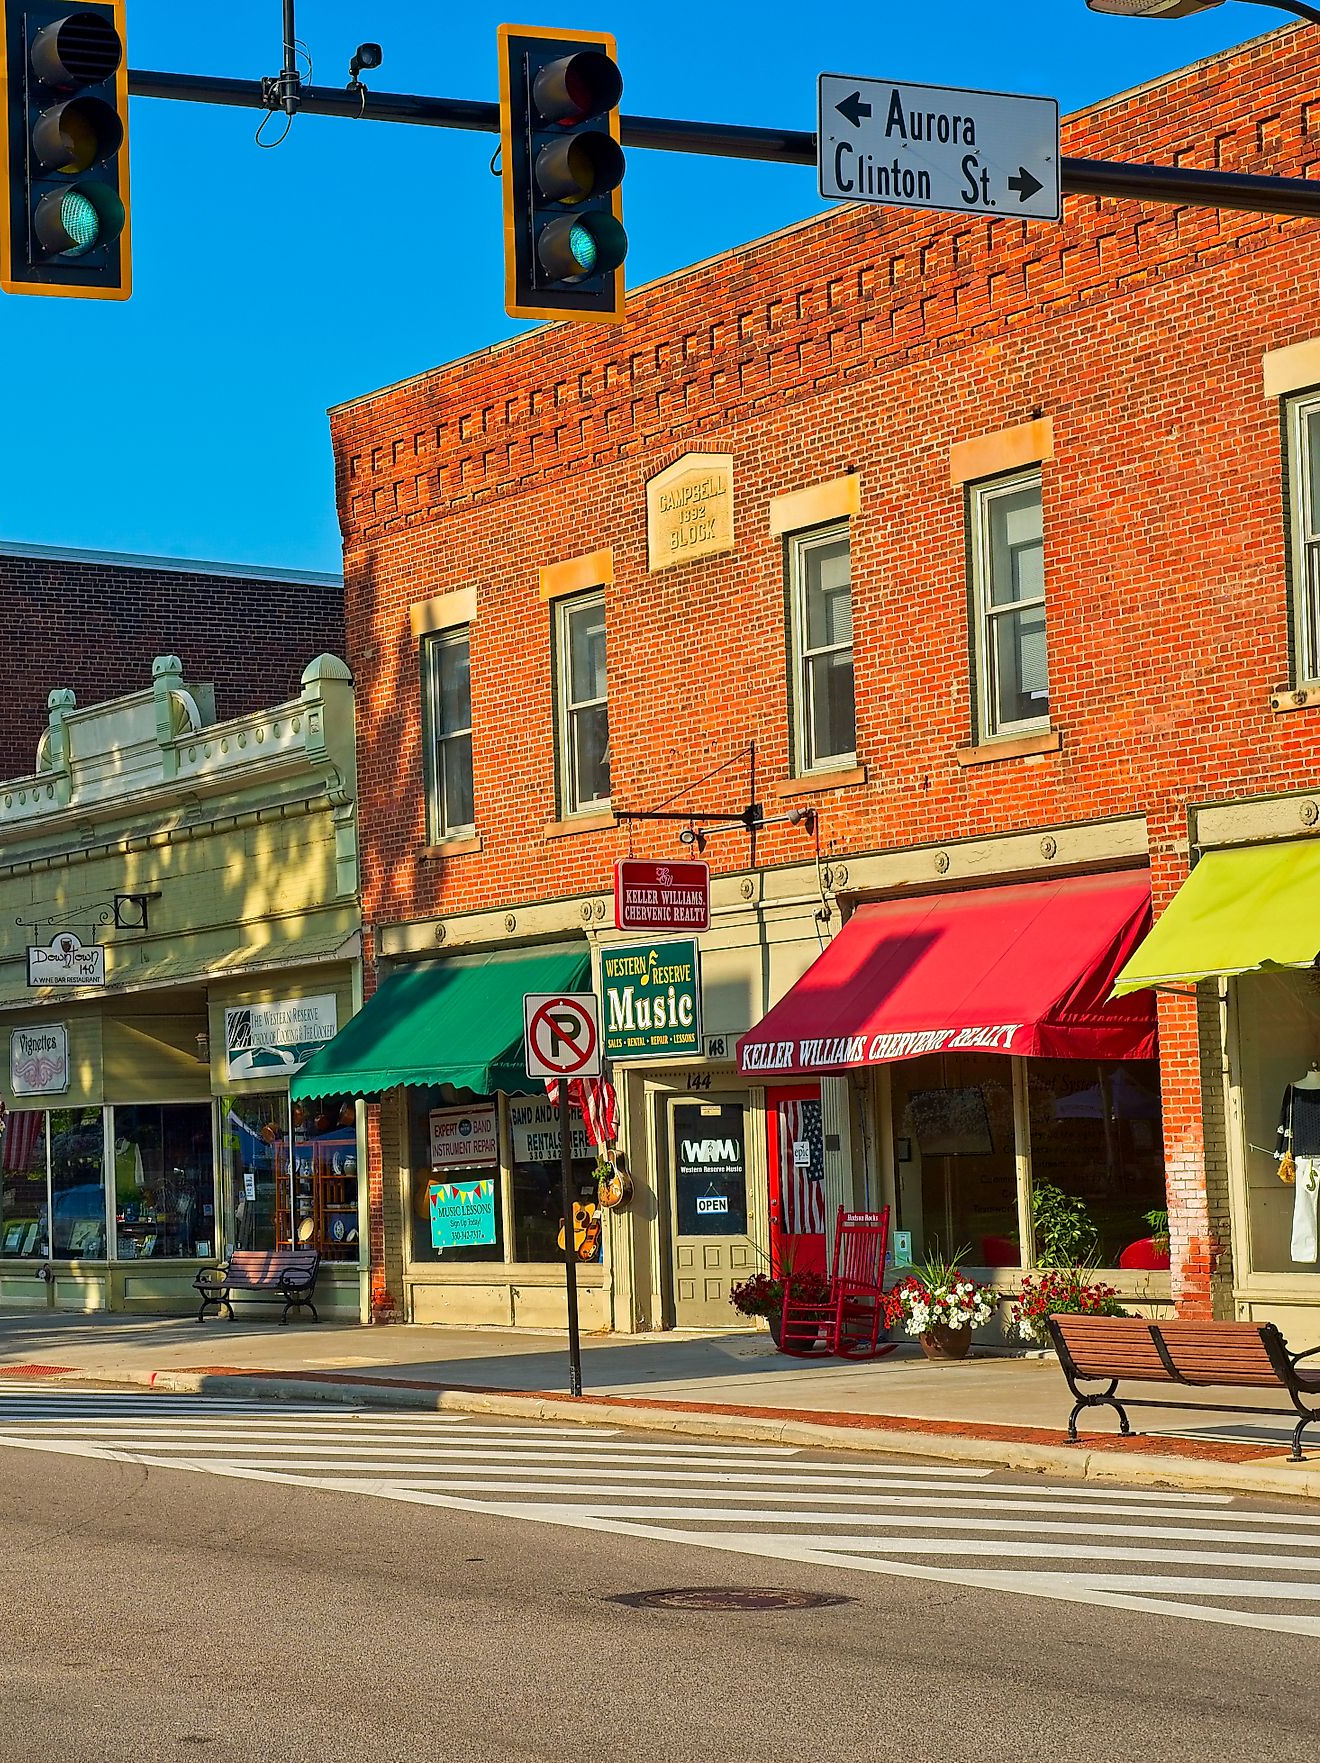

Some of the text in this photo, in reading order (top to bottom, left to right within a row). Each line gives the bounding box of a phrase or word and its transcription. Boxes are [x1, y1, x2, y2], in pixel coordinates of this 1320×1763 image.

[884, 89, 976, 147] Aurora
[834, 141, 996, 207] Clinton St.
[659, 475, 727, 513] CAMPBELL
[670, 518, 716, 550] BLOCK
[625, 889, 659, 905] KELLER
[624, 905, 706, 922] CHERVENIC REALTY
[79, 964, 95, 975] 140
[605, 955, 692, 985] WESTERN RESERVE
[607, 985, 694, 1033] Music
[19, 1033, 57, 1056] Vignettes
[607, 1033, 696, 1049] SALES RENTAL REPAIR LESSONS
[708, 1038, 725, 1056] 148
[741, 1040, 794, 1071] KELLER
[868, 1029, 955, 1061] CHERVENIC
[948, 1023, 1024, 1049] REALTY
[686, 1073, 712, 1090] 144
[511, 1107, 533, 1126] BAND
[535, 1104, 552, 1123] AND
[434, 1122, 458, 1138] EXPERT
[473, 1119, 492, 1134] BAND
[433, 1138, 496, 1157] INSTRUMENT REPAIR
[529, 1151, 543, 1160] 330
[547, 1150, 562, 1159] 342
[680, 1165, 703, 1173] Western
[725, 1165, 743, 1173] Music
[438, 1203, 492, 1218] MUSIC LESSONS
[698, 1199, 727, 1211] OPEN
[449, 1219, 460, 1229] Sign
[460, 1219, 467, 1228] Up
